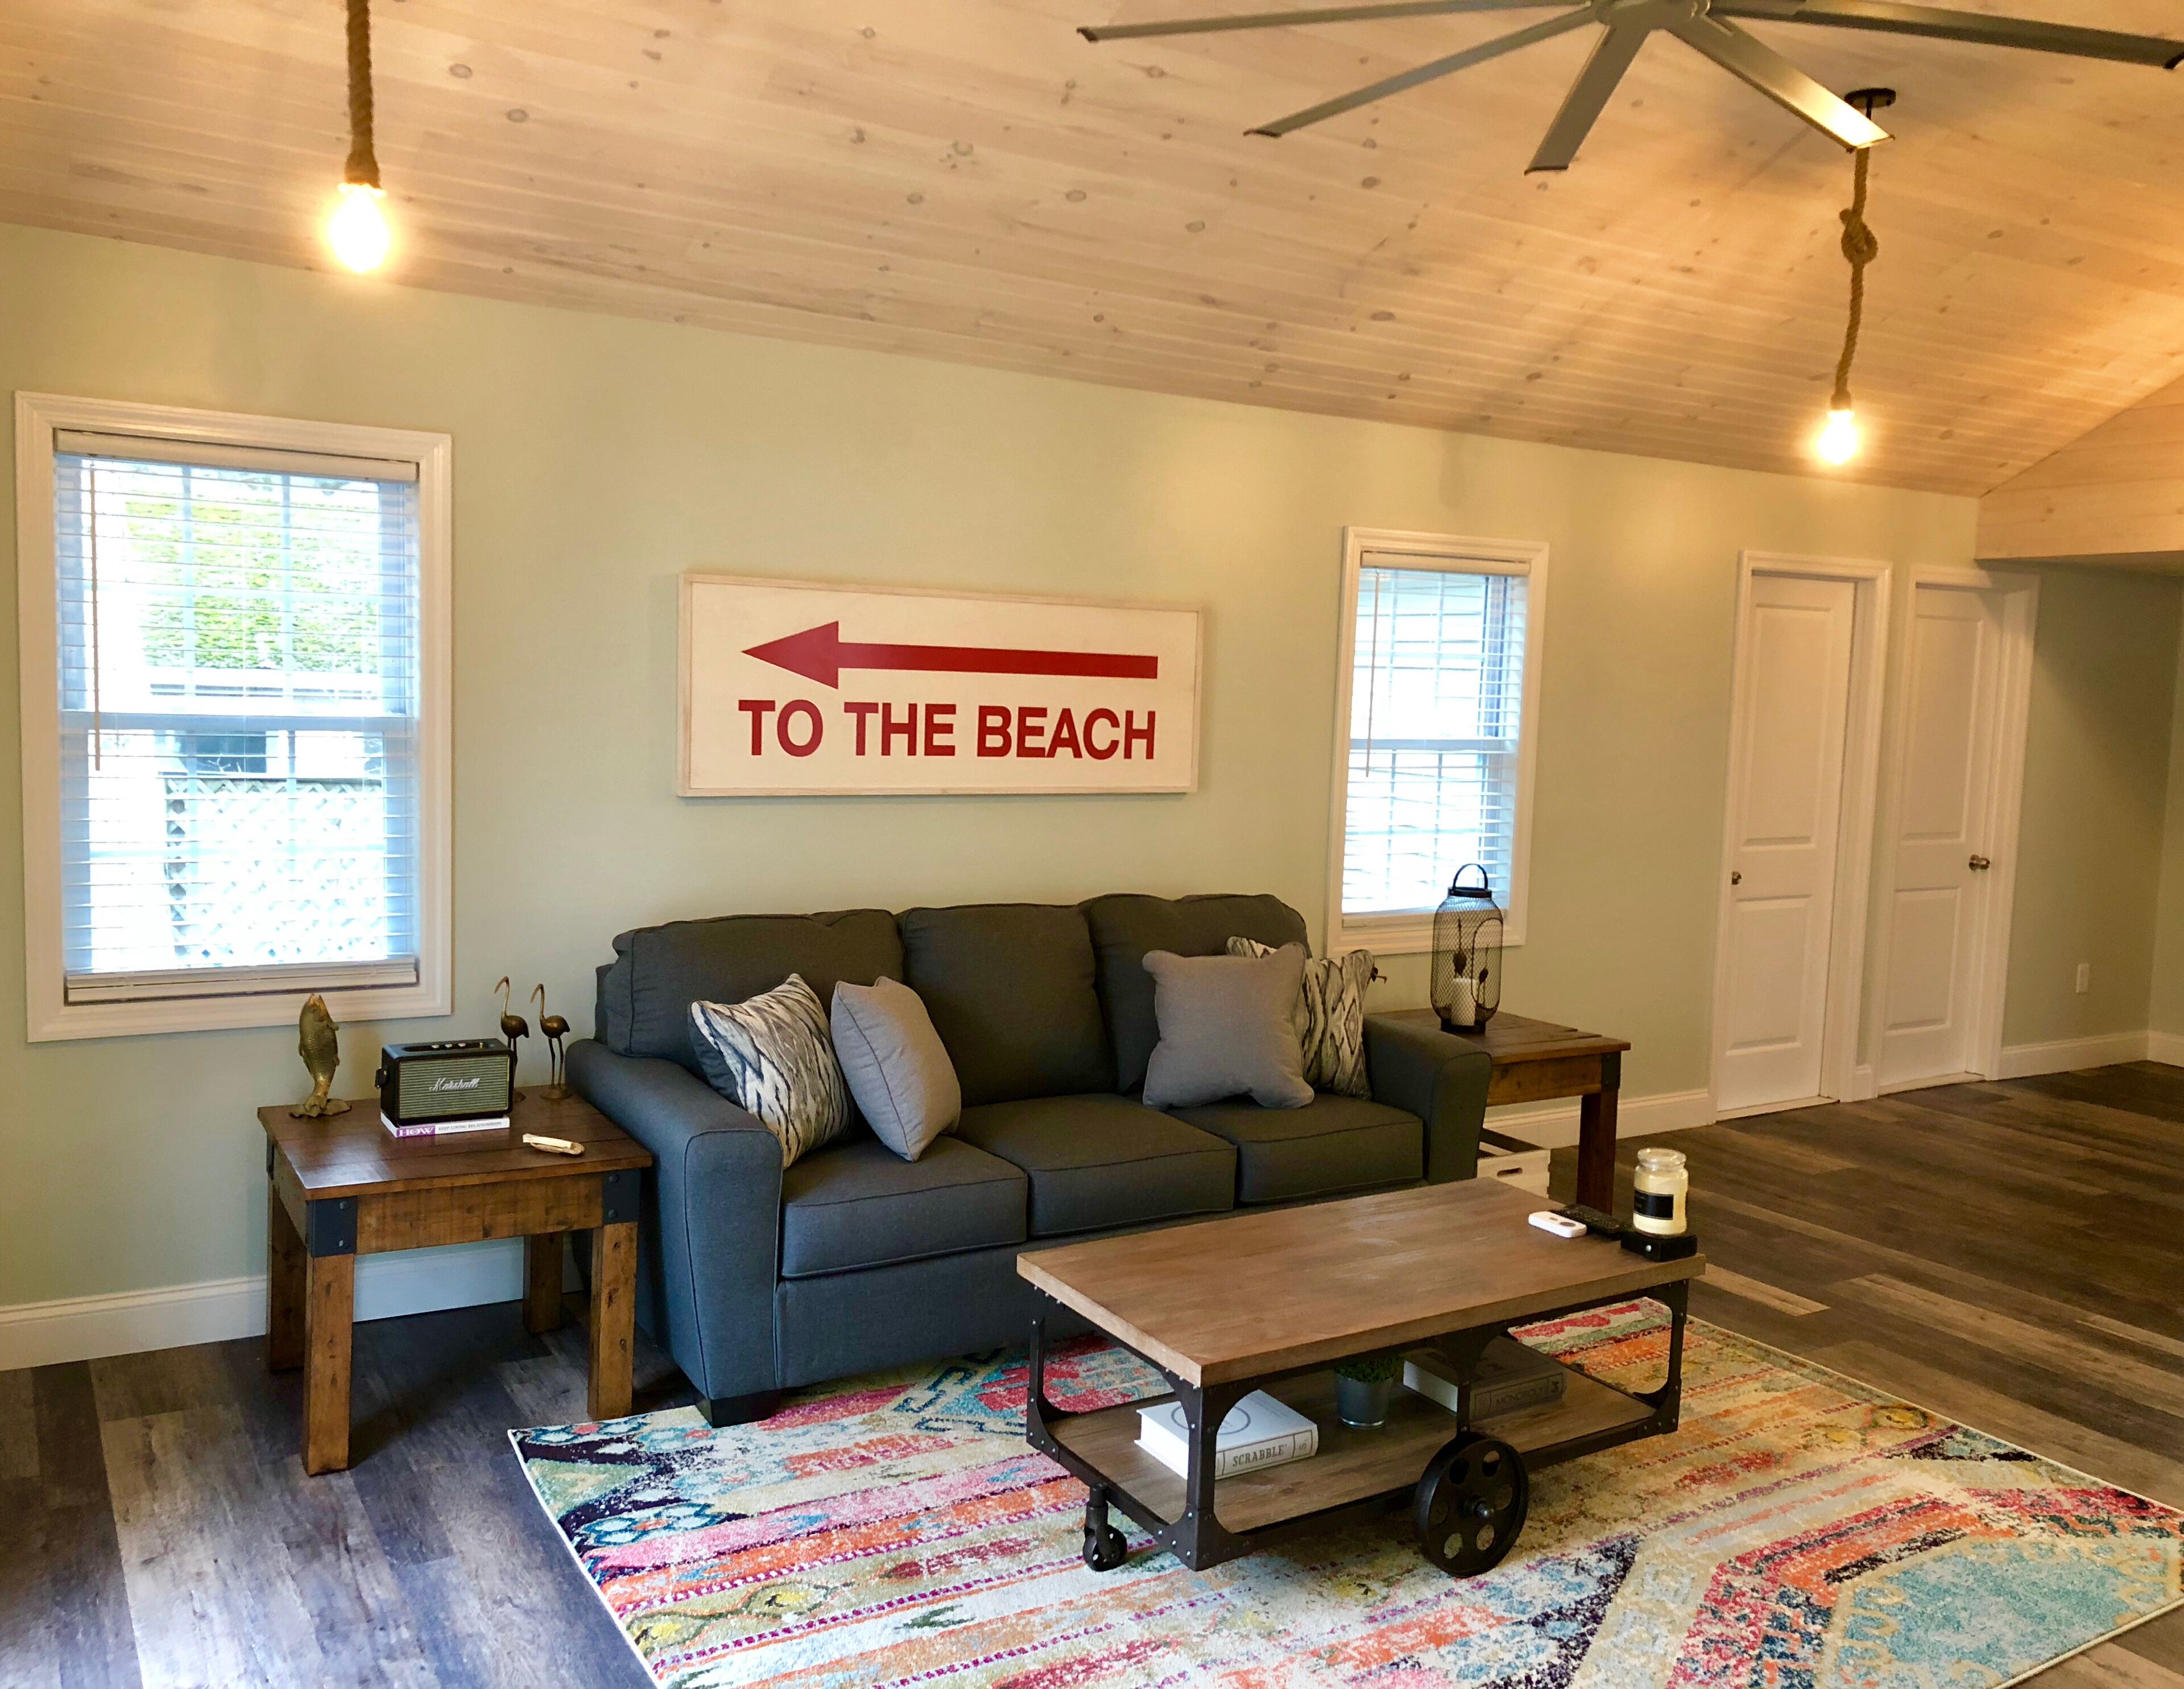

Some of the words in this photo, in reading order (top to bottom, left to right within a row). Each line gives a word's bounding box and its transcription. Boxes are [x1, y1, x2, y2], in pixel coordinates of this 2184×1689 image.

[738, 699, 824, 757] TO
[843, 701, 957, 757] THE
[977, 705, 1156, 761] BEACH
[429, 1077, 480, 1092] Marshall
[399, 1127, 434, 1137] HOW
